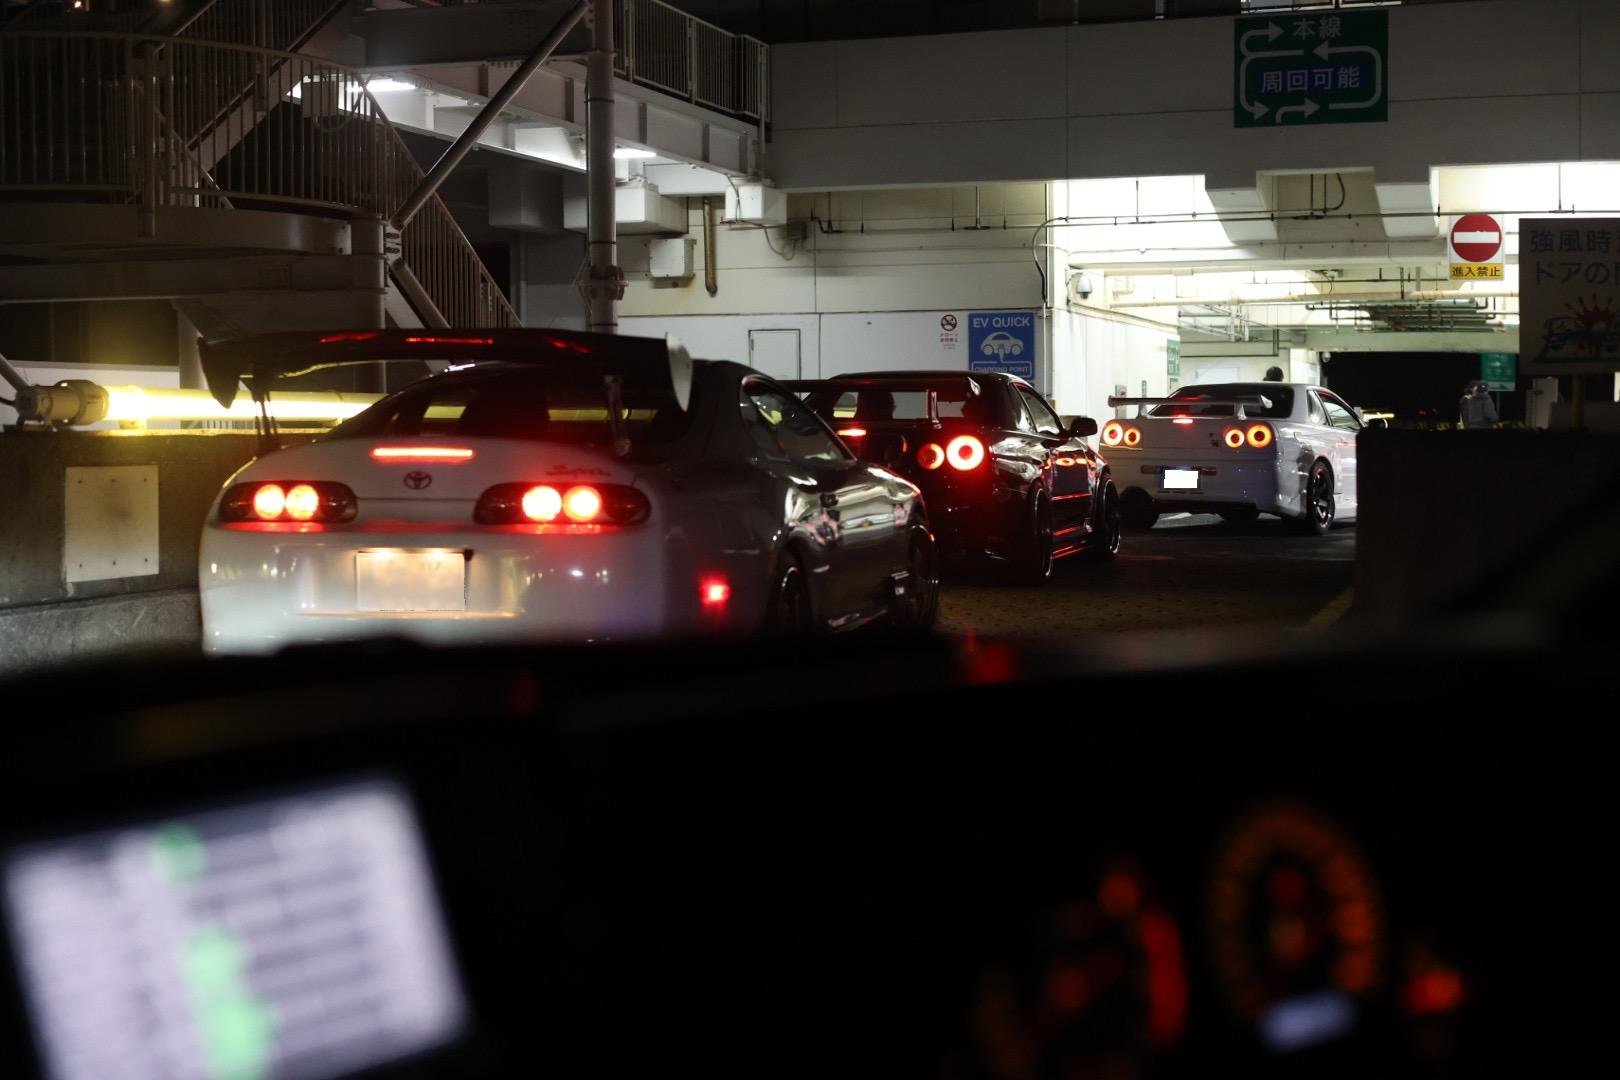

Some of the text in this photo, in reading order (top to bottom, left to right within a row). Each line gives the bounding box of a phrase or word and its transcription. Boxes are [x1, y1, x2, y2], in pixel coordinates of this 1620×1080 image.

[1292, 16, 1342, 40] 本線
[1261, 66, 1360, 93] 周回可能
[1530, 228, 1620, 253] 強風時
[1452, 266, 1501, 278] 進入禁止
[973, 316, 1030, 328] EV QUICK
